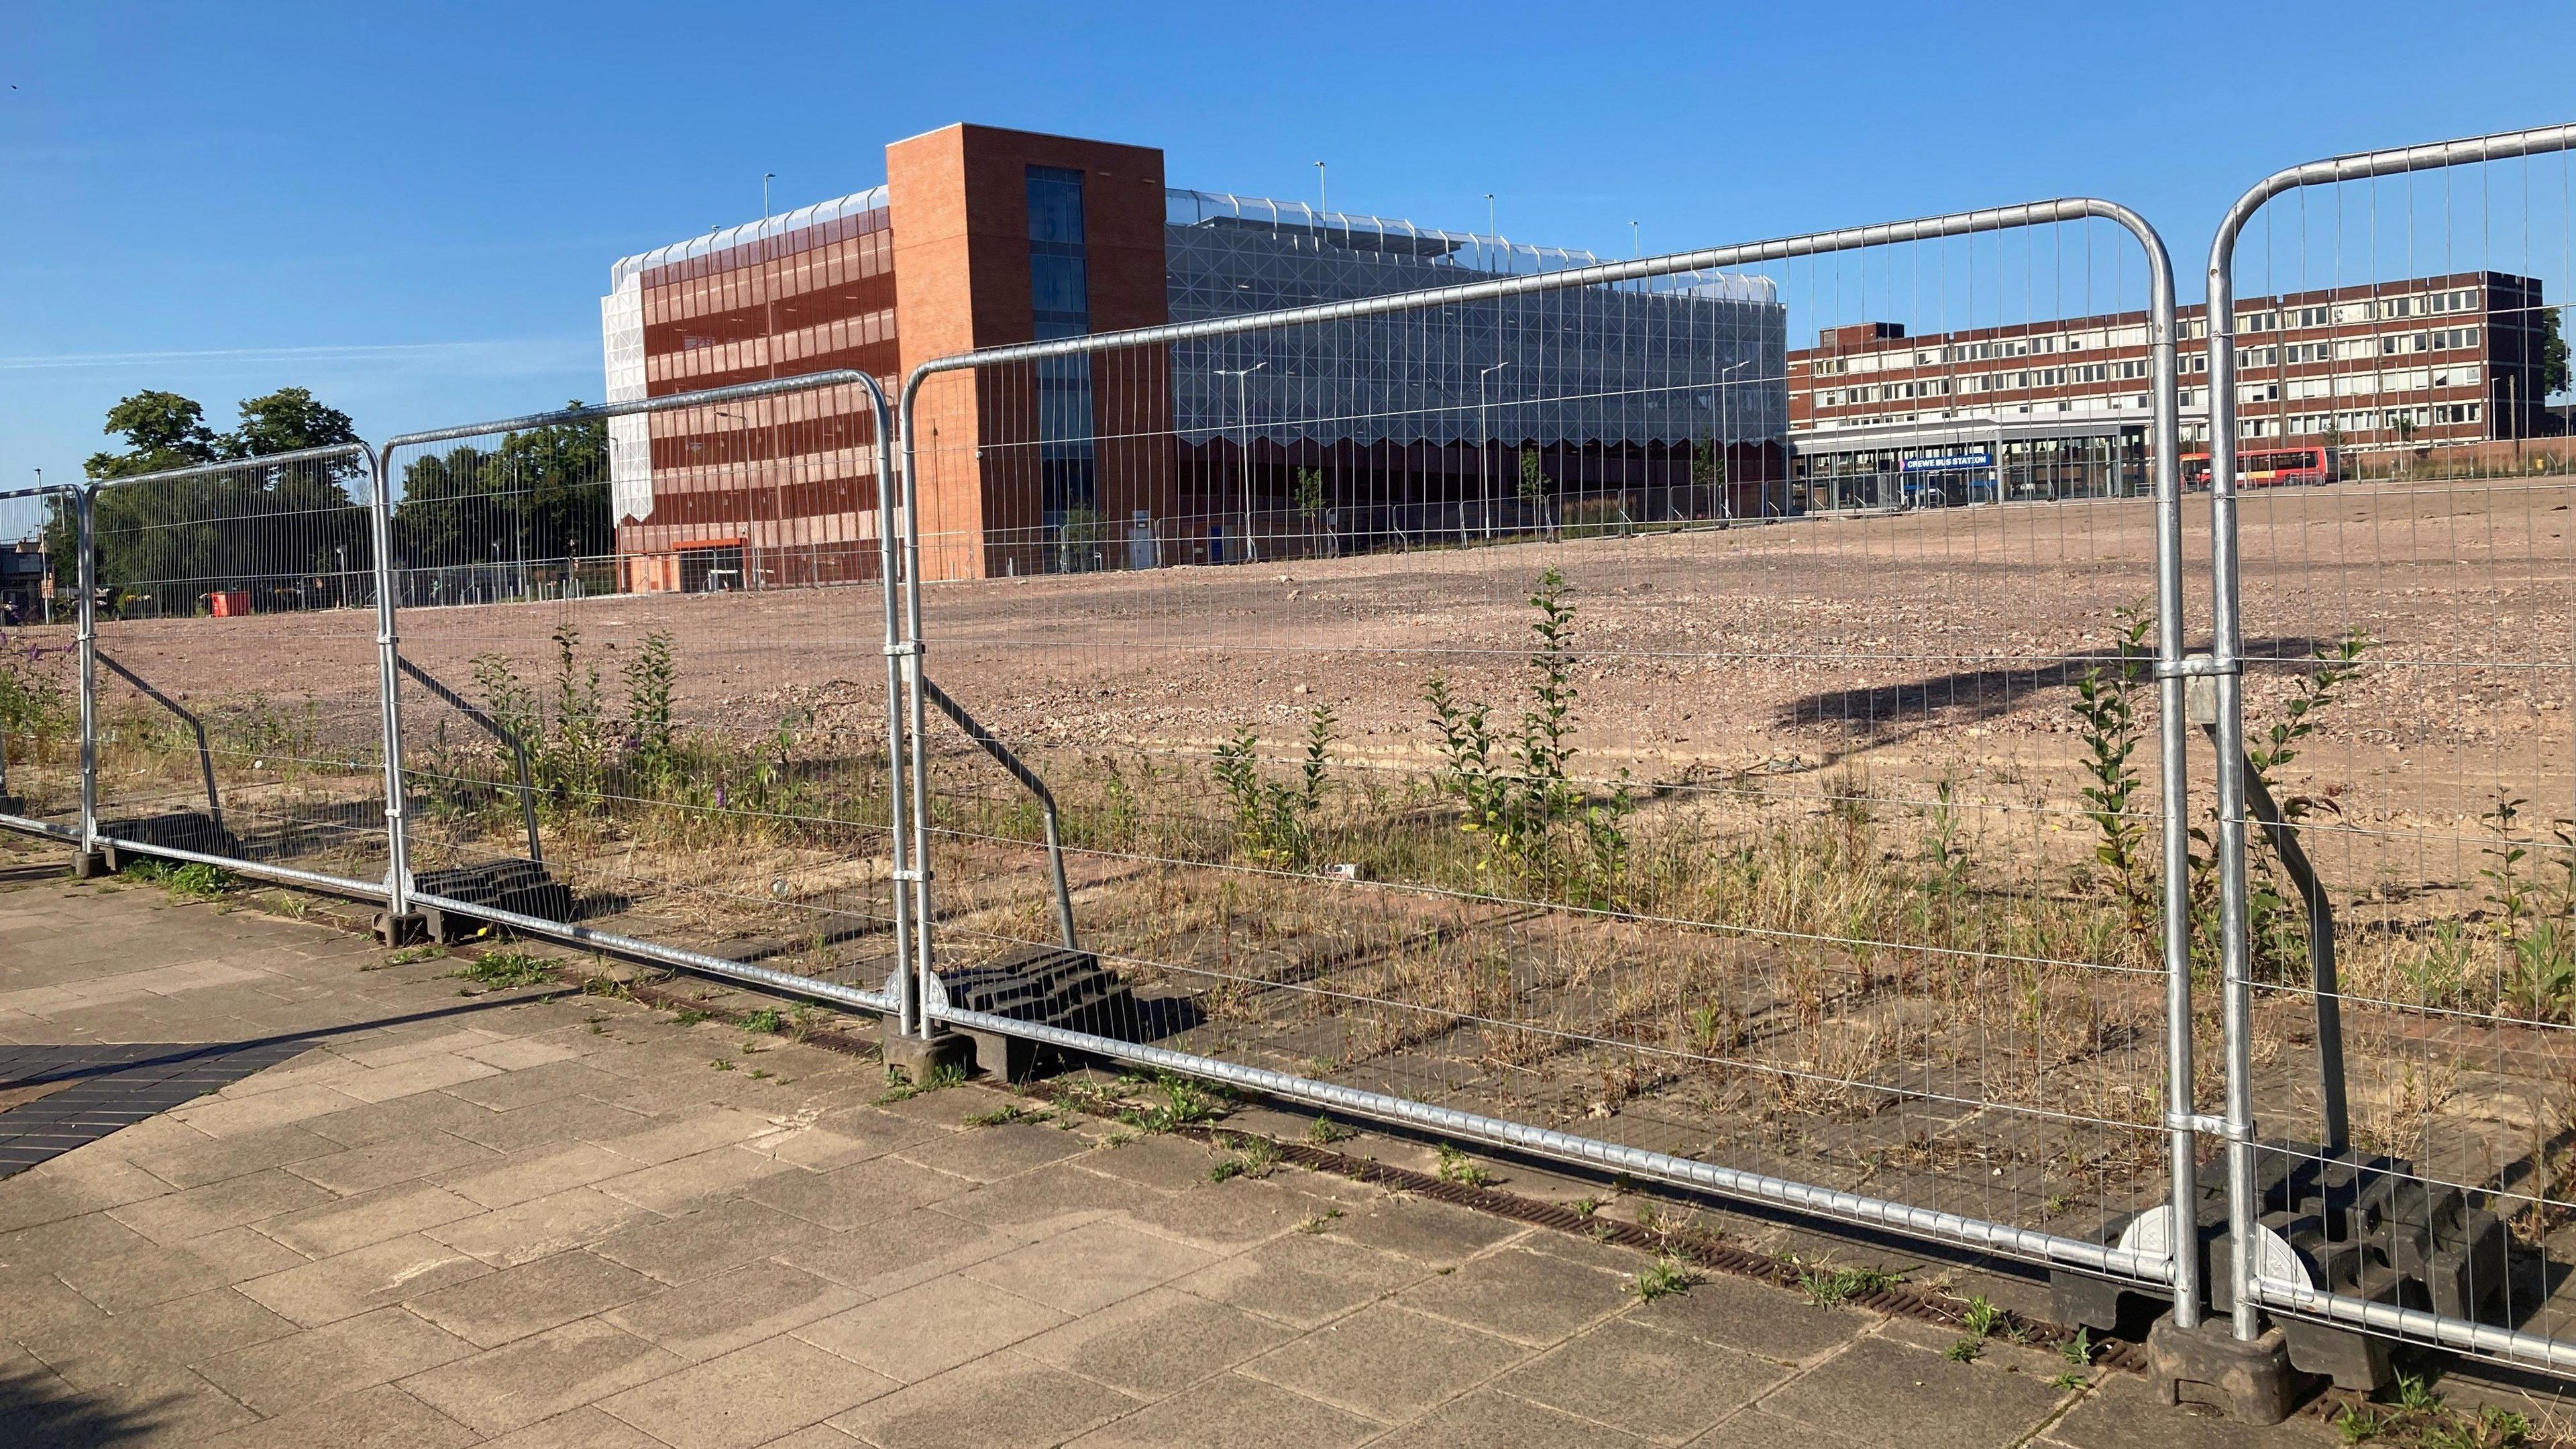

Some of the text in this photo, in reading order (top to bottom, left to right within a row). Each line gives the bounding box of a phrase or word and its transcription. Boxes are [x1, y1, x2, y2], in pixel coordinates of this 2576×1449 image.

[1907, 455, 1986, 468] CREWE BUS STATION
